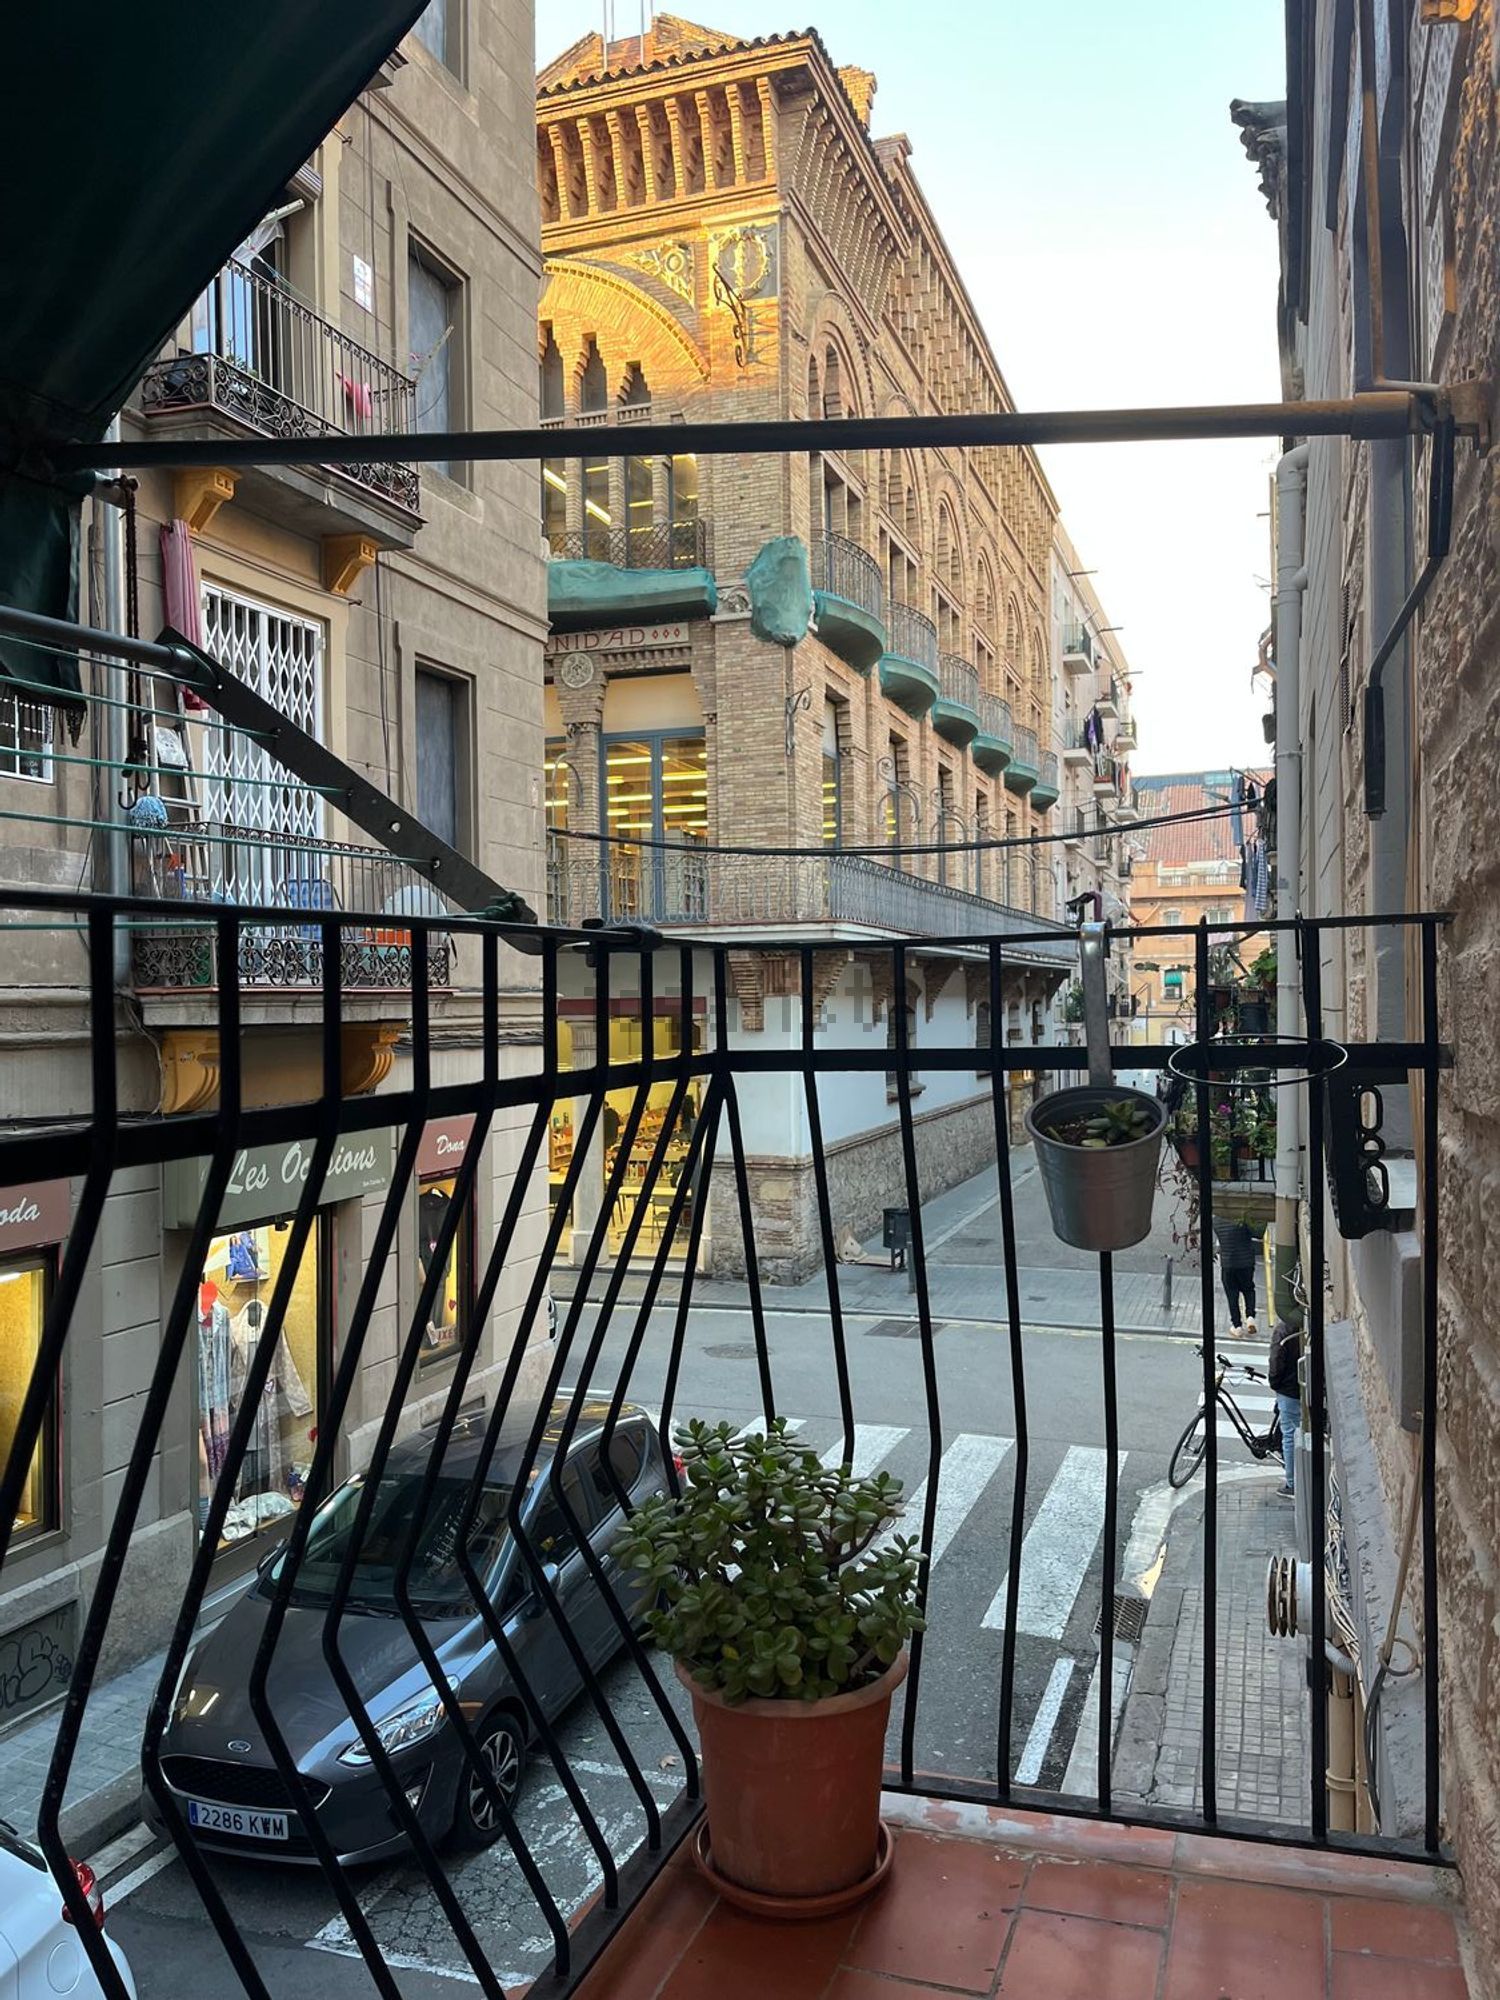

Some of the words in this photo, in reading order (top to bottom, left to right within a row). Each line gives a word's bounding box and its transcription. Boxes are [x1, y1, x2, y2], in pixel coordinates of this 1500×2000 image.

[436, 1135, 464, 1155] Dona
[225, 1150, 270, 1195] Les
[281, 1142, 378, 1184] Ocsions
[201, 1807, 243, 1831] 2286
